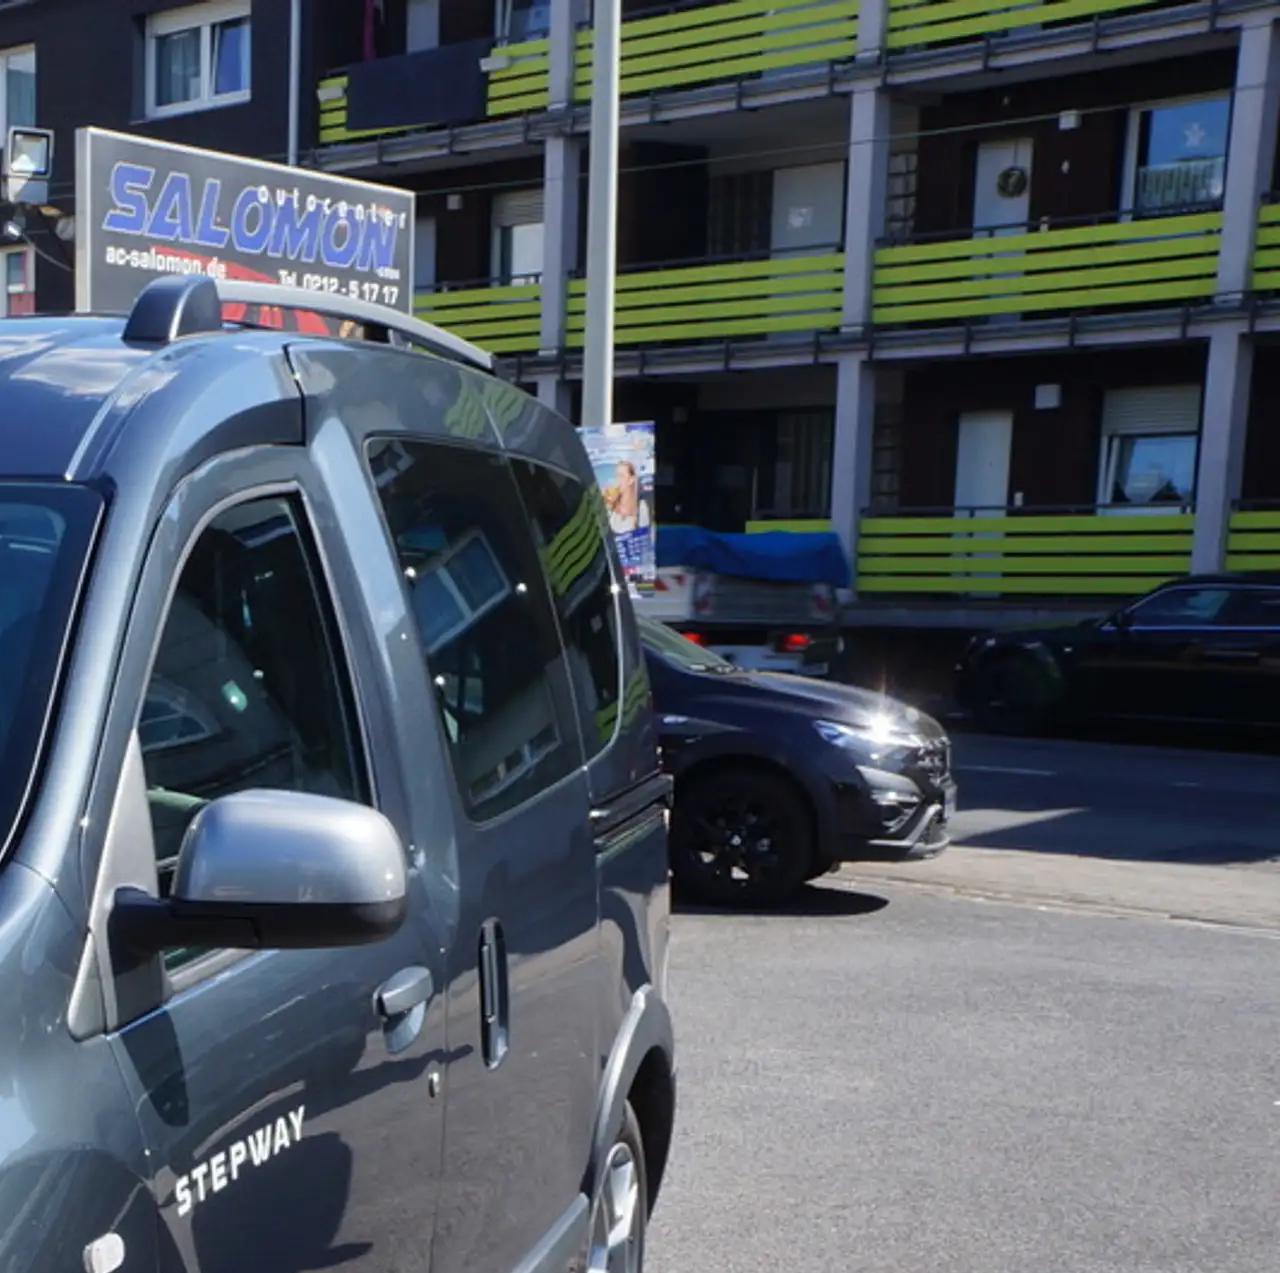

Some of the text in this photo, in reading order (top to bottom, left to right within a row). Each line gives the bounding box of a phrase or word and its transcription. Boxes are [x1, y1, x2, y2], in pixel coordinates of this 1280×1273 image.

[102, 161, 397, 271] SALOMON
[105, 246, 227, 280] ac-salomon.de
[175, 1104, 306, 1217] STEPWAY
